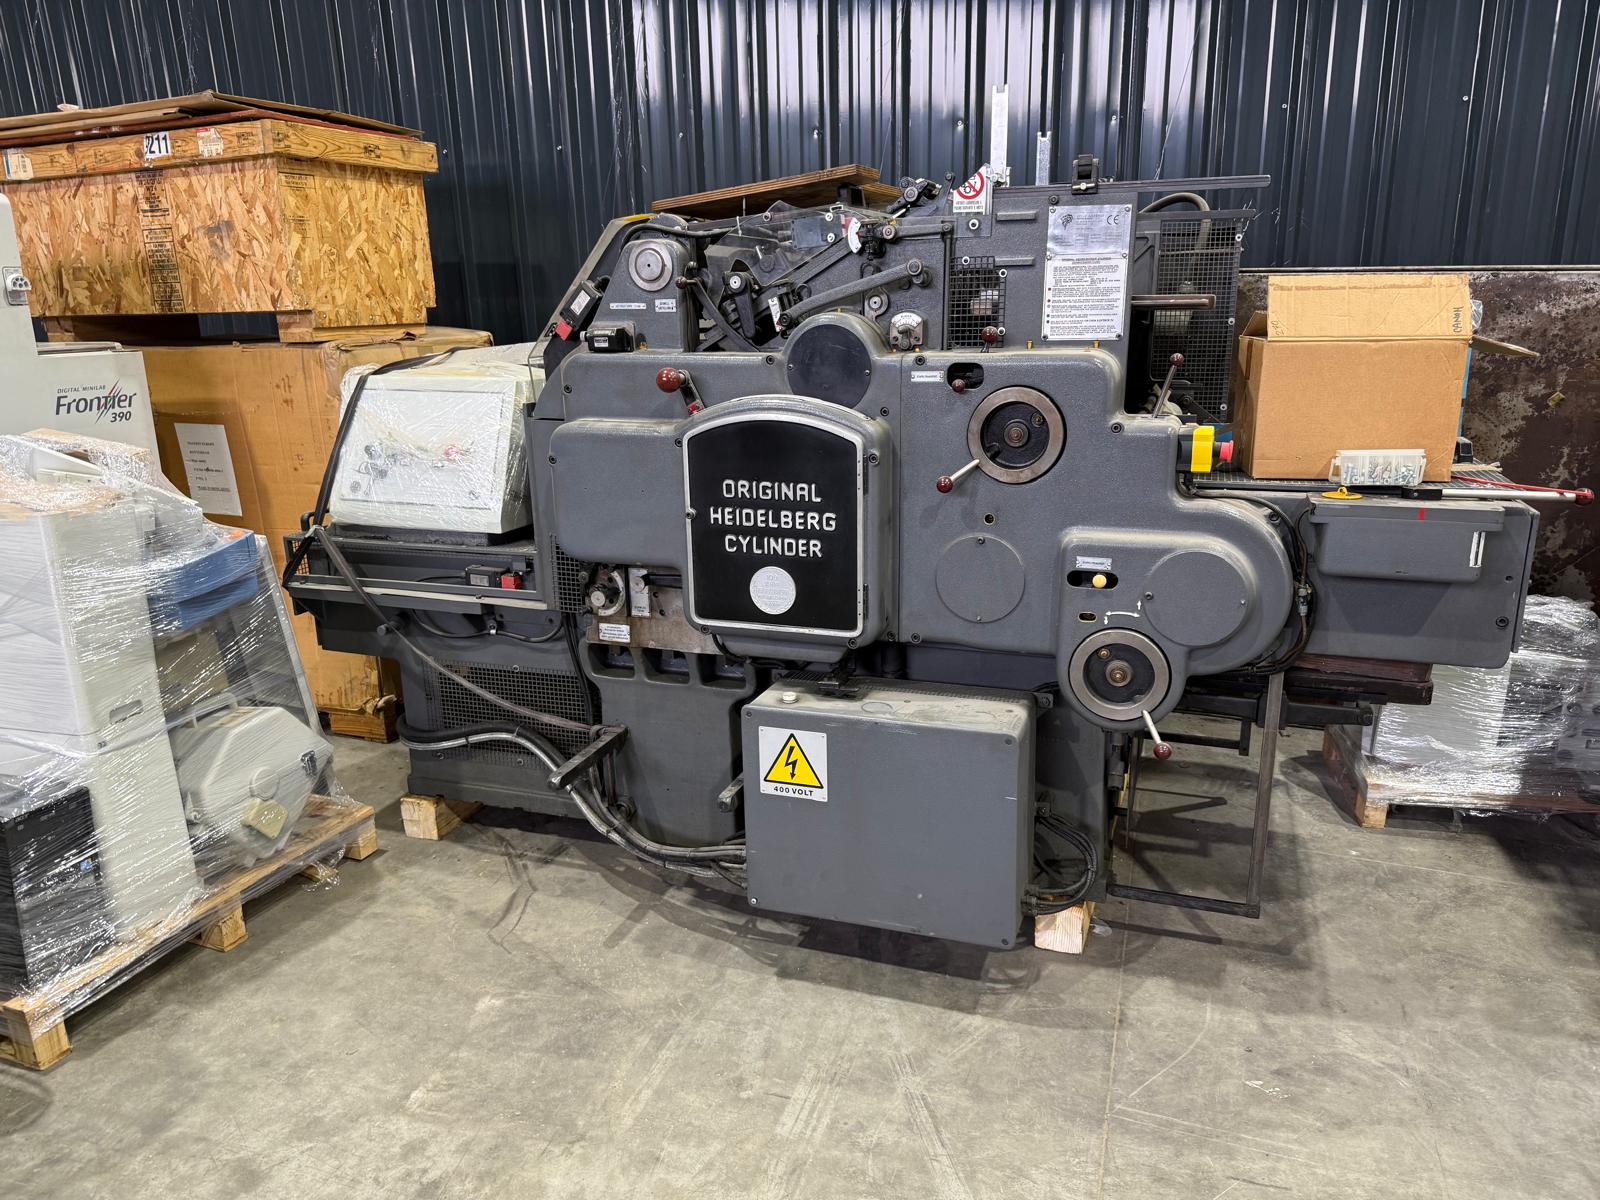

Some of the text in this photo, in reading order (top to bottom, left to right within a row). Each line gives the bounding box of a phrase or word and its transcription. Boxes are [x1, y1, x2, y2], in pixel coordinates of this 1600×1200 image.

[56, 393, 137, 415] Frontier
[110, 411, 132, 423] 390
[722, 479, 822, 502] ORIGINAL
[710, 506, 837, 531] HEIDELBERG
[725, 534, 822, 558] CYLINDER
[791, 788, 814, 797] VOLT
